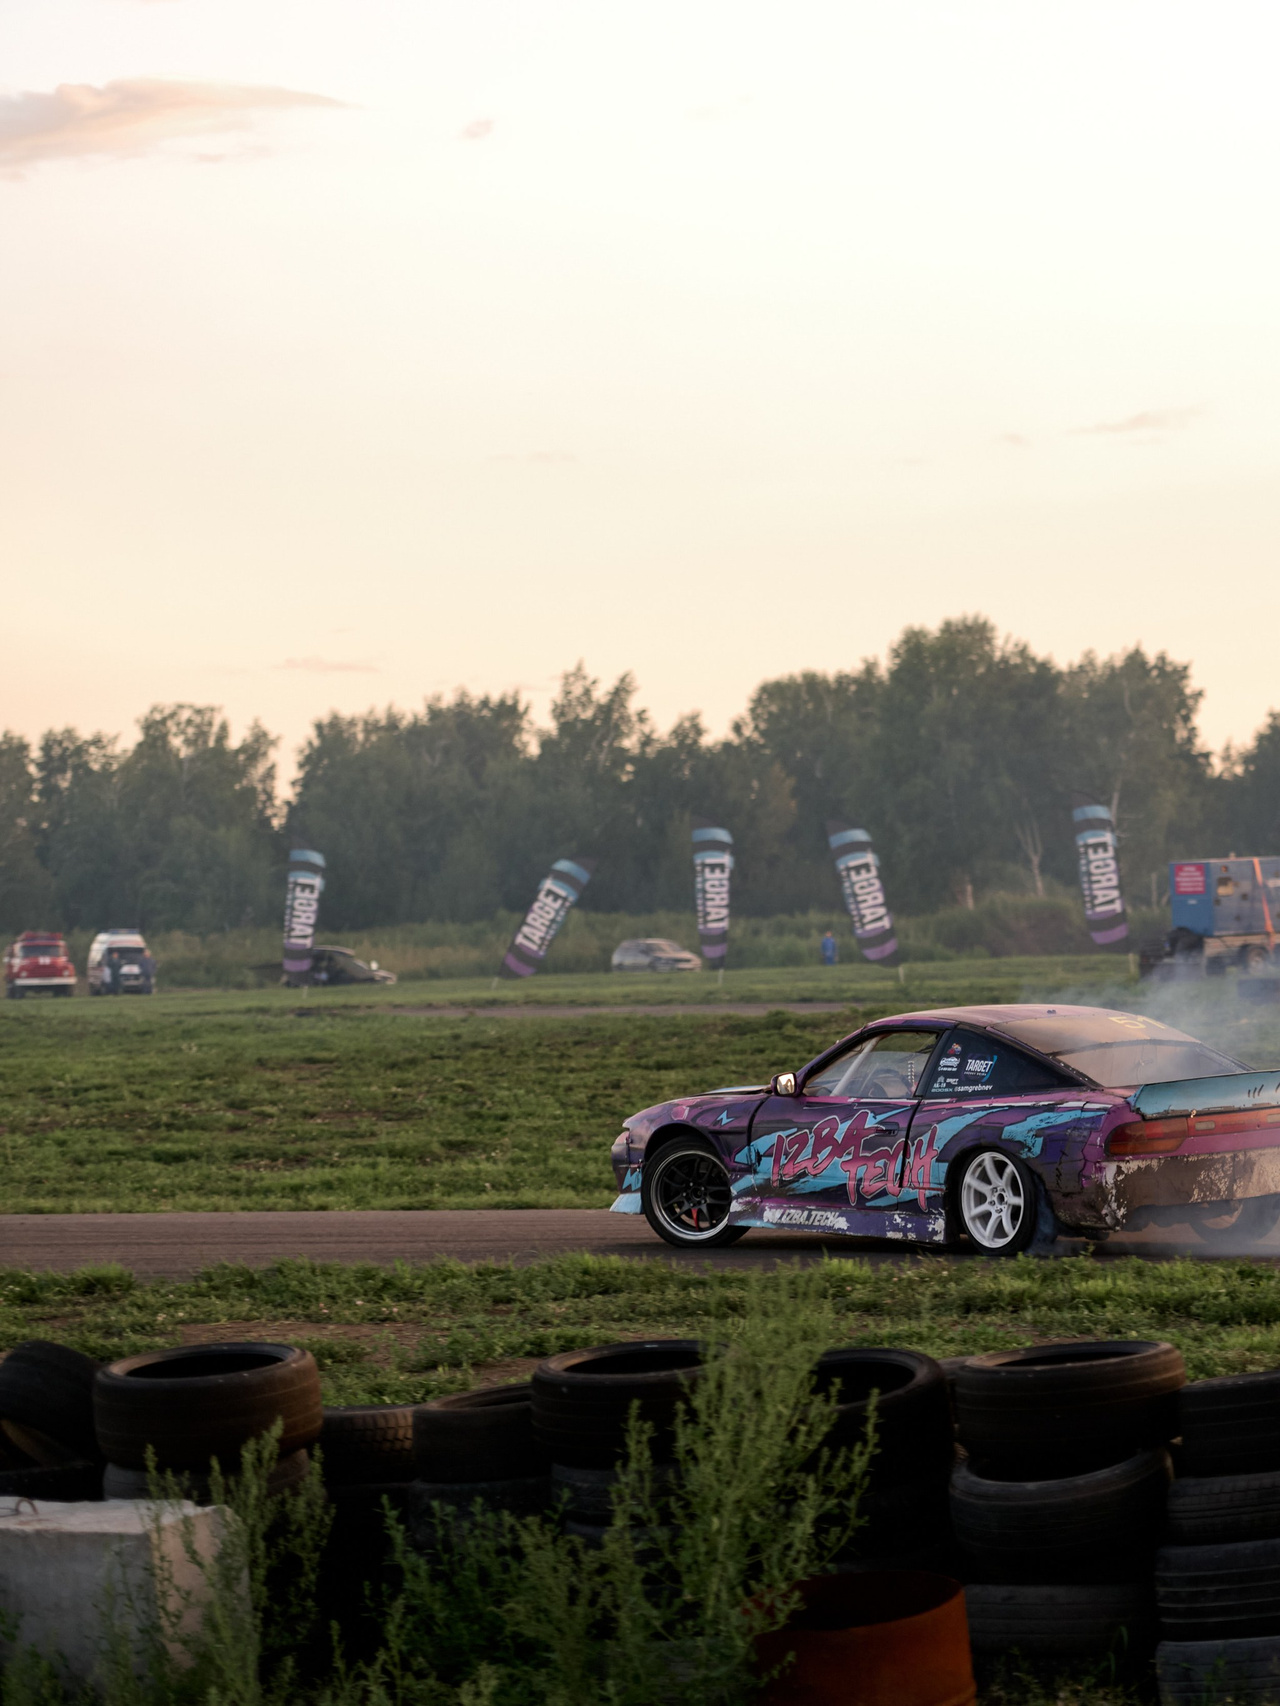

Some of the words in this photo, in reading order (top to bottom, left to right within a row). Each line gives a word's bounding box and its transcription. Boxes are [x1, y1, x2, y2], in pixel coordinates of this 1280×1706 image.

[515, 875, 568, 951] TARGET
[965, 1059, 993, 1072] TARGET
[771, 1110, 885, 1188] IZBA
[839, 1125, 939, 1212] TECH
